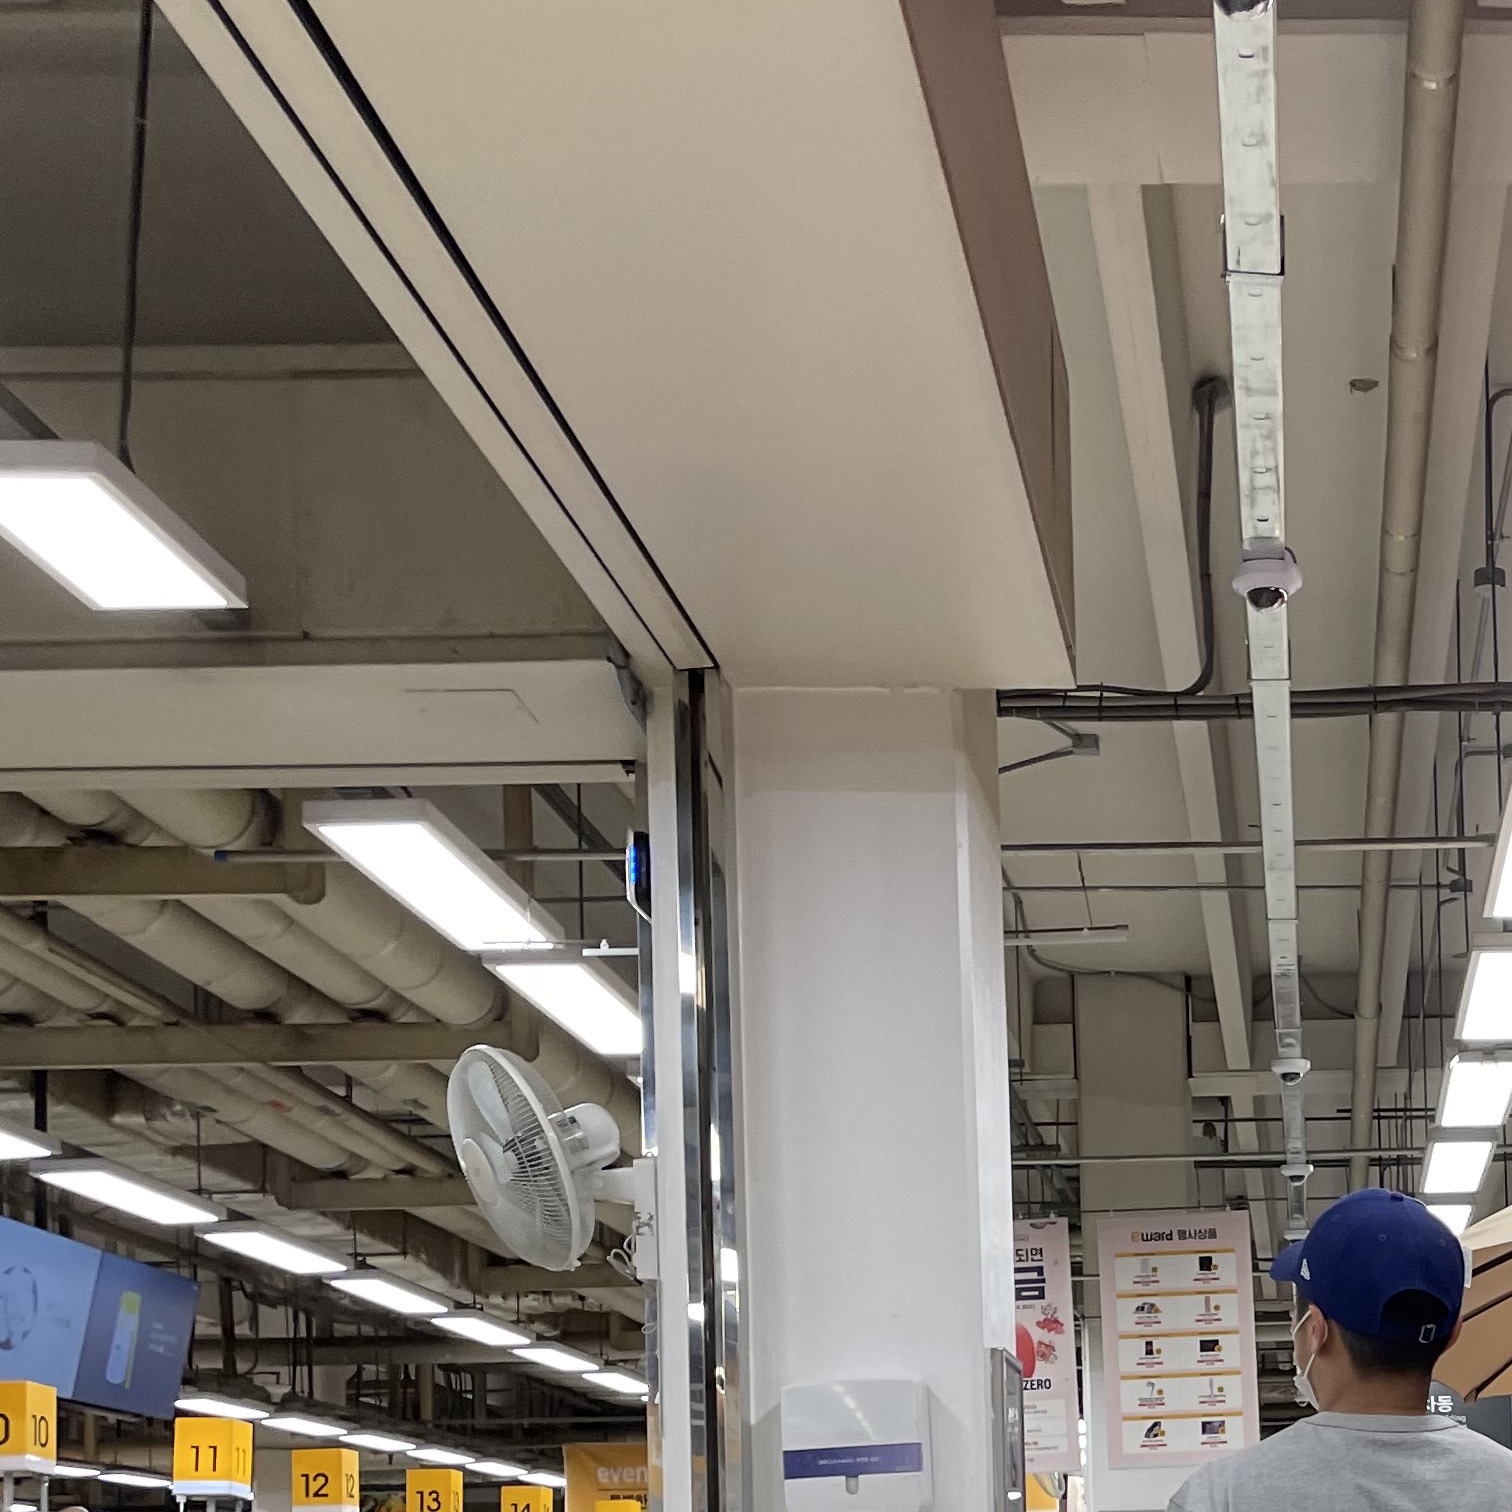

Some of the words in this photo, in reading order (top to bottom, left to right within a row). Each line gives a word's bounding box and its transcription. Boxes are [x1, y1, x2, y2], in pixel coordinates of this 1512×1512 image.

[1022, 1378, 1052, 1391] ZERO
[31, 1414, 49, 1447] 10
[191, 1445, 218, 1473] 11
[236, 1446, 246, 1477] 11
[301, 1473, 329, 1499] 12
[345, 1473, 355, 1499] 12
[416, 1490, 441, 1512] 13
